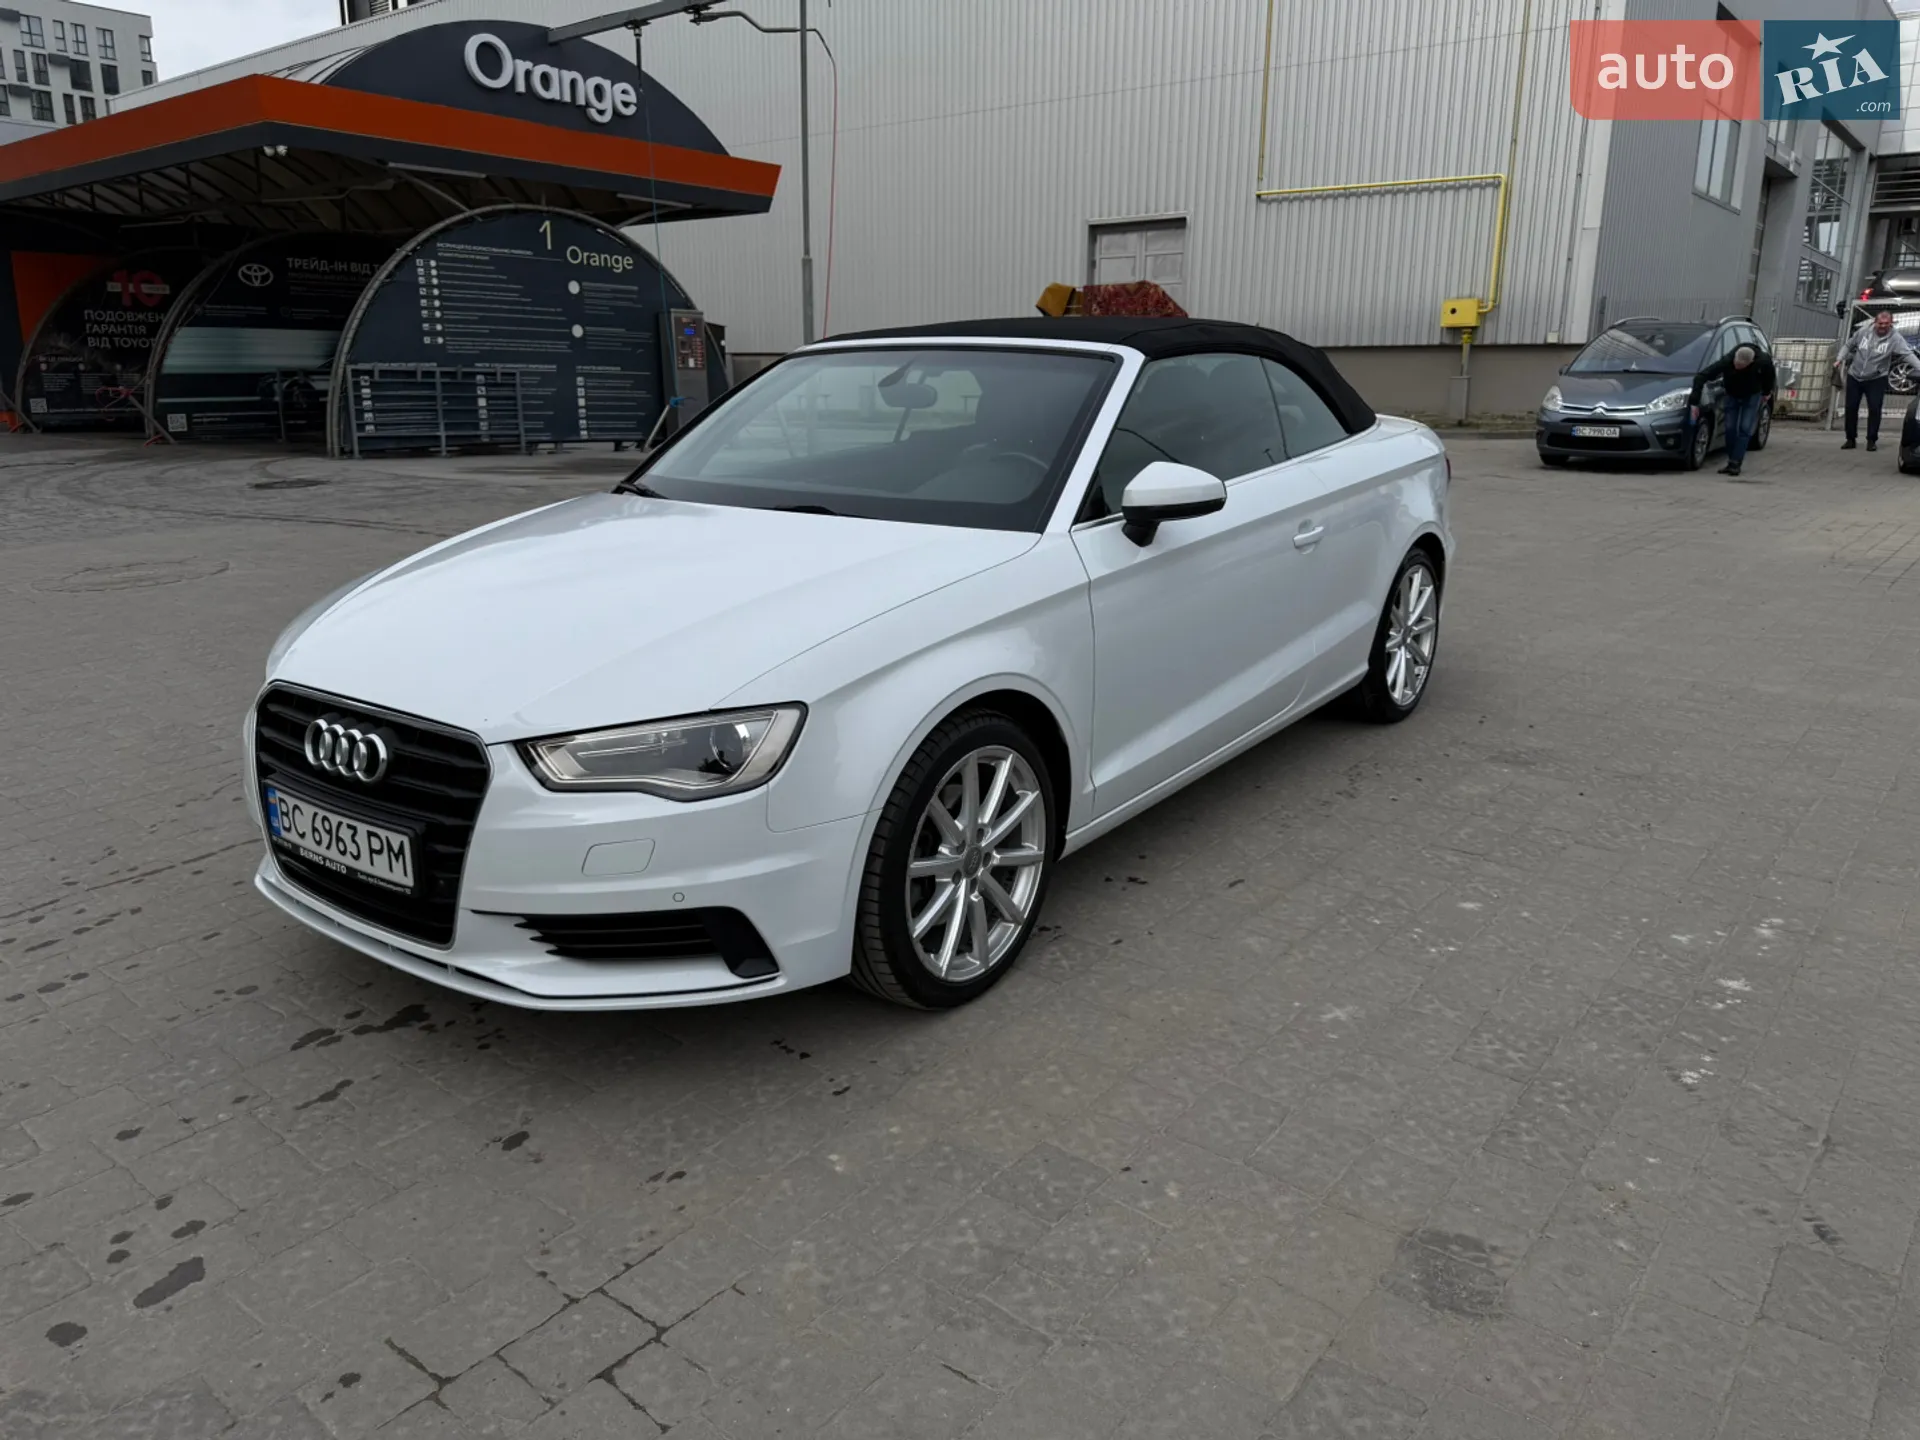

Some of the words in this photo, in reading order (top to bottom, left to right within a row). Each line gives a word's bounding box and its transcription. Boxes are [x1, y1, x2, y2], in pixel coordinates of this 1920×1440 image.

[464, 33, 638, 124] Orange
[539, 220, 553, 250] 1
[286, 256, 348, 273] ТРЕЙД-ІН
[349, 262, 372, 276] ВІД
[566, 245, 634, 273] Orange
[113, 270, 164, 307] 10
[83, 310, 165, 323] ПОДОВЖЕН
[85, 323, 147, 335] ГАРАНТІЯ
[87, 336, 111, 349] ВІД
[112, 337, 157, 349] TOYOT
[279, 796, 306, 839] BC
[312, 812, 361, 861] 6963
[367, 830, 409, 878] PM
[299, 848, 324, 865] BERNS
[325, 860, 347, 875] AUTO
